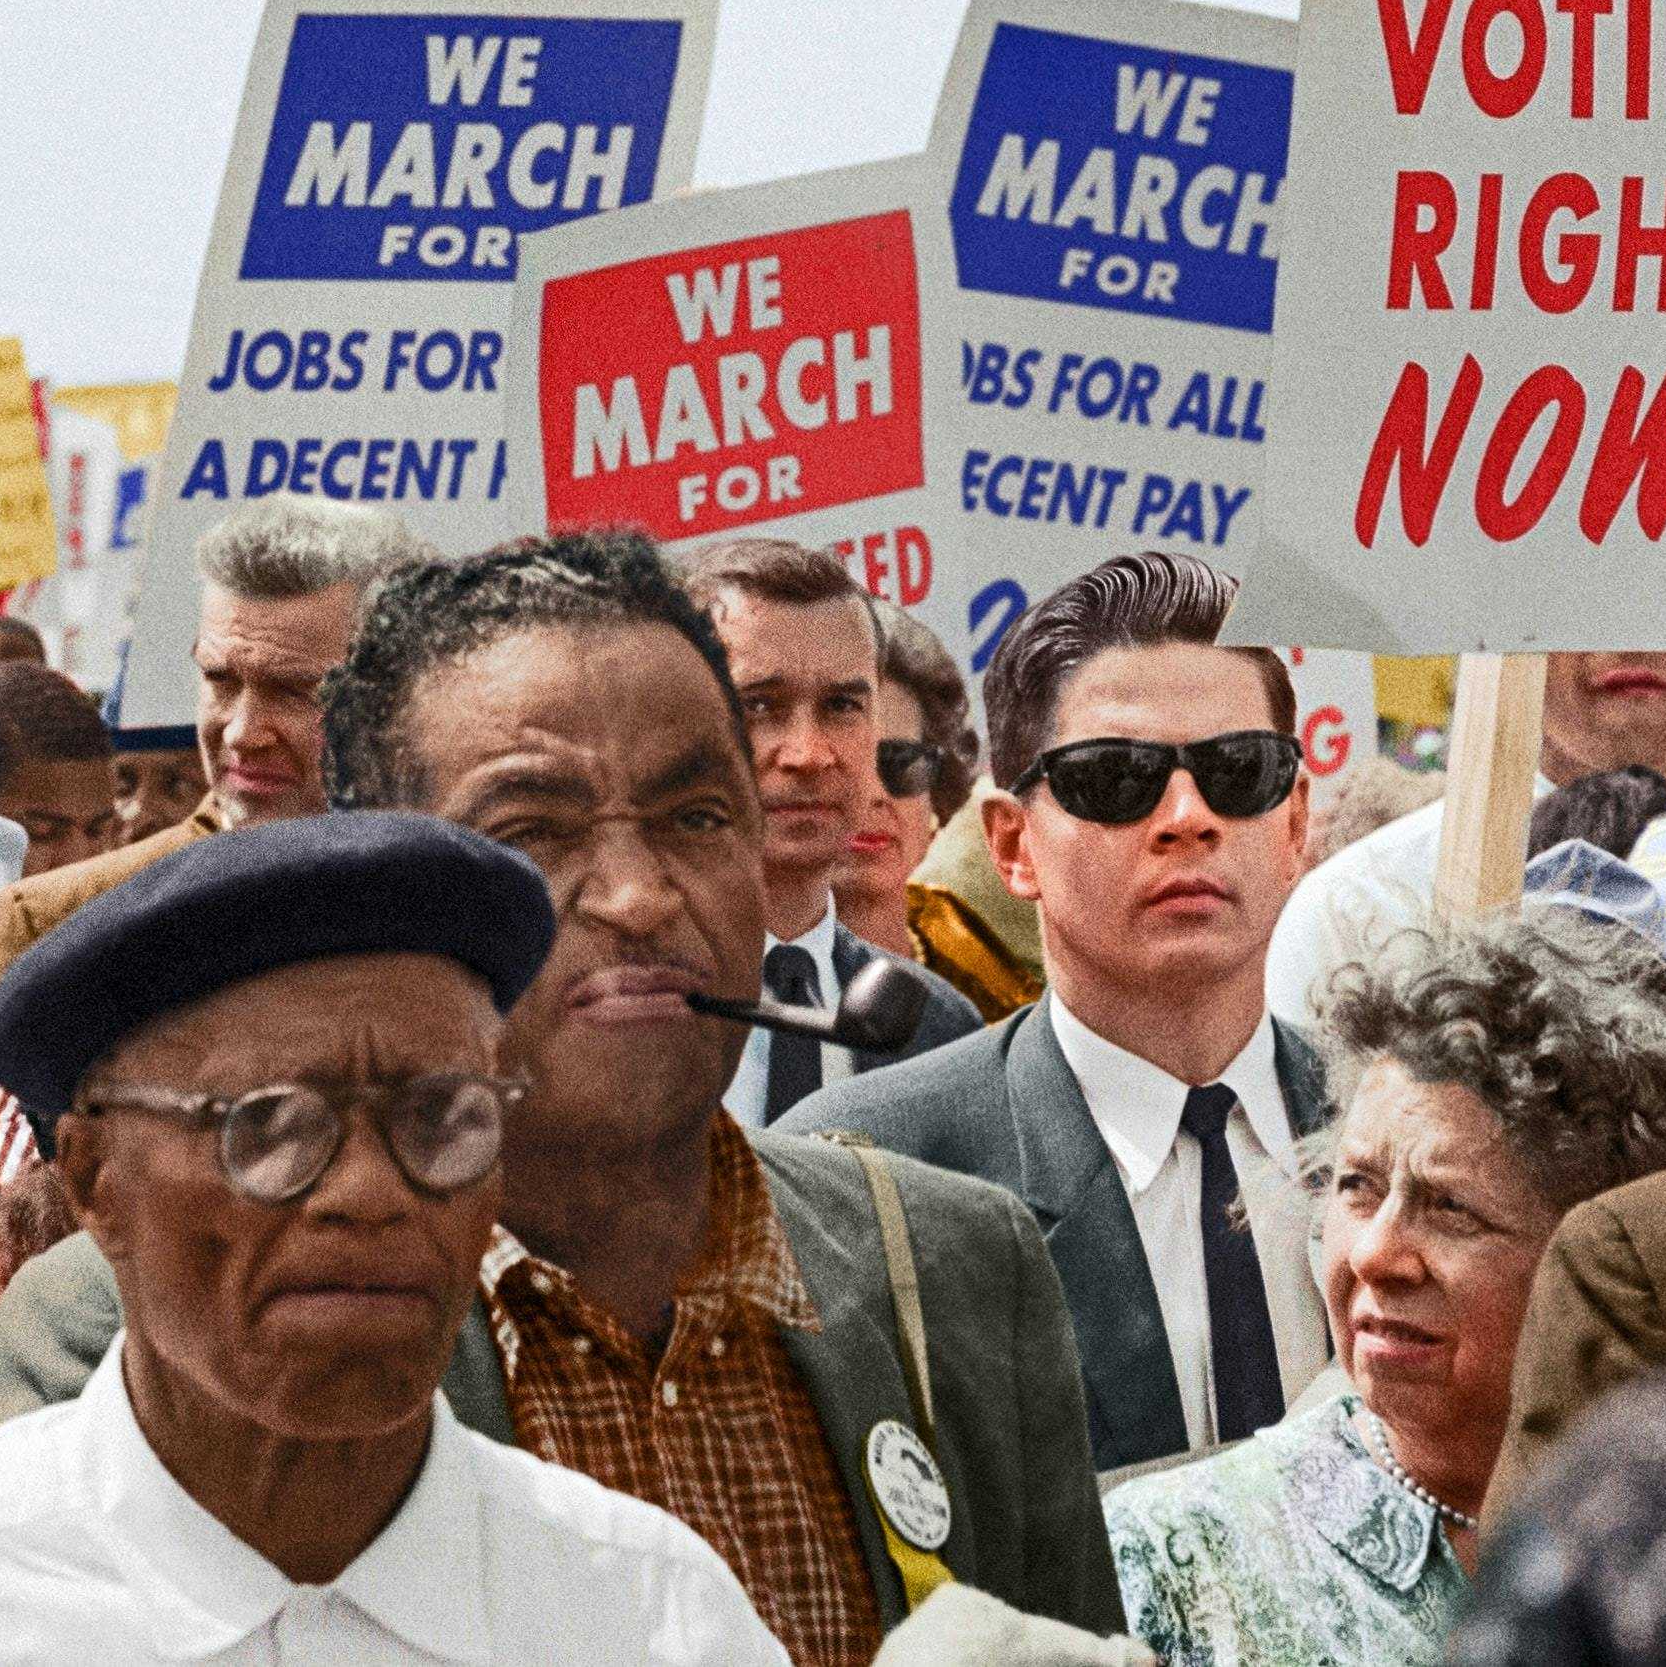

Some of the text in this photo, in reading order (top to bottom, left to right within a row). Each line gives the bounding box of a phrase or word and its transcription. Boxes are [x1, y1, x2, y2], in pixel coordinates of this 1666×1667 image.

[425, 34, 544, 109] WE
[1117, 65, 1221, 146] WE
[285, 121, 634, 211] MARCH
[976, 135, 1288, 262] MARCH
[378, 225, 511, 269] FOR
[1059, 249, 1179, 302] FOR
[667, 256, 784, 343] WE
[209, 330, 504, 392] JOBS FOR
[1048, 352, 1161, 426] FOR
[1167, 372, 1266, 444] ALL
[572, 326, 893, 479] MARCH
[180, 439, 230, 500] A
[244, 439, 478, 500] DECENT
[678, 455, 803, 521] FOR
[961, 451, 1251, 546] ECENT PAY
